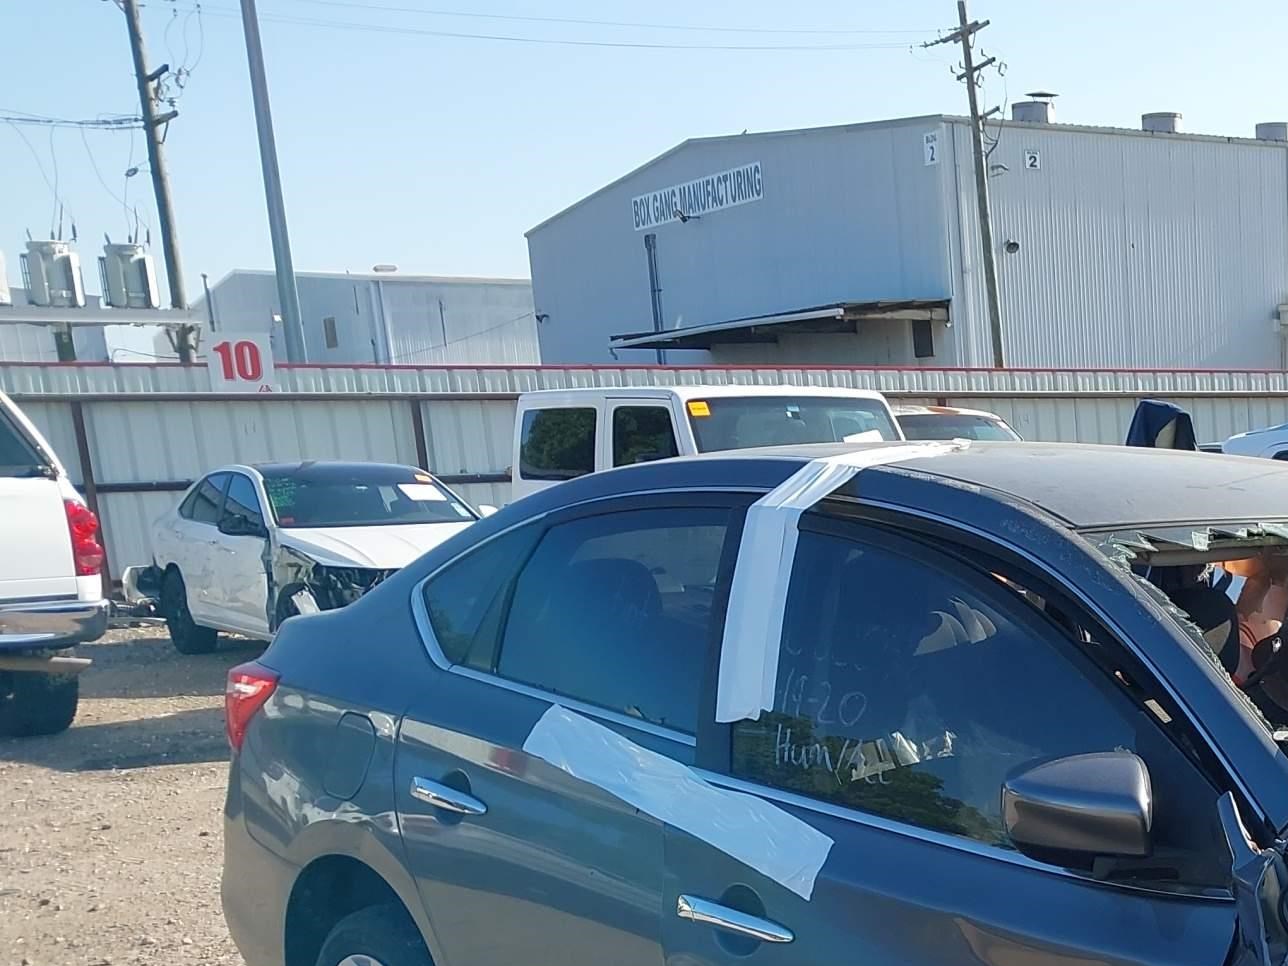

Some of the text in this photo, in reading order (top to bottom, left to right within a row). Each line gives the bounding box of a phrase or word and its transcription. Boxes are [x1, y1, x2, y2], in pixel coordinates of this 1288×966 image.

[1028, 155, 1037, 168] 2
[633, 164, 763, 229] BOX GANG MANUFACTURING
[212, 340, 264, 381] 10
